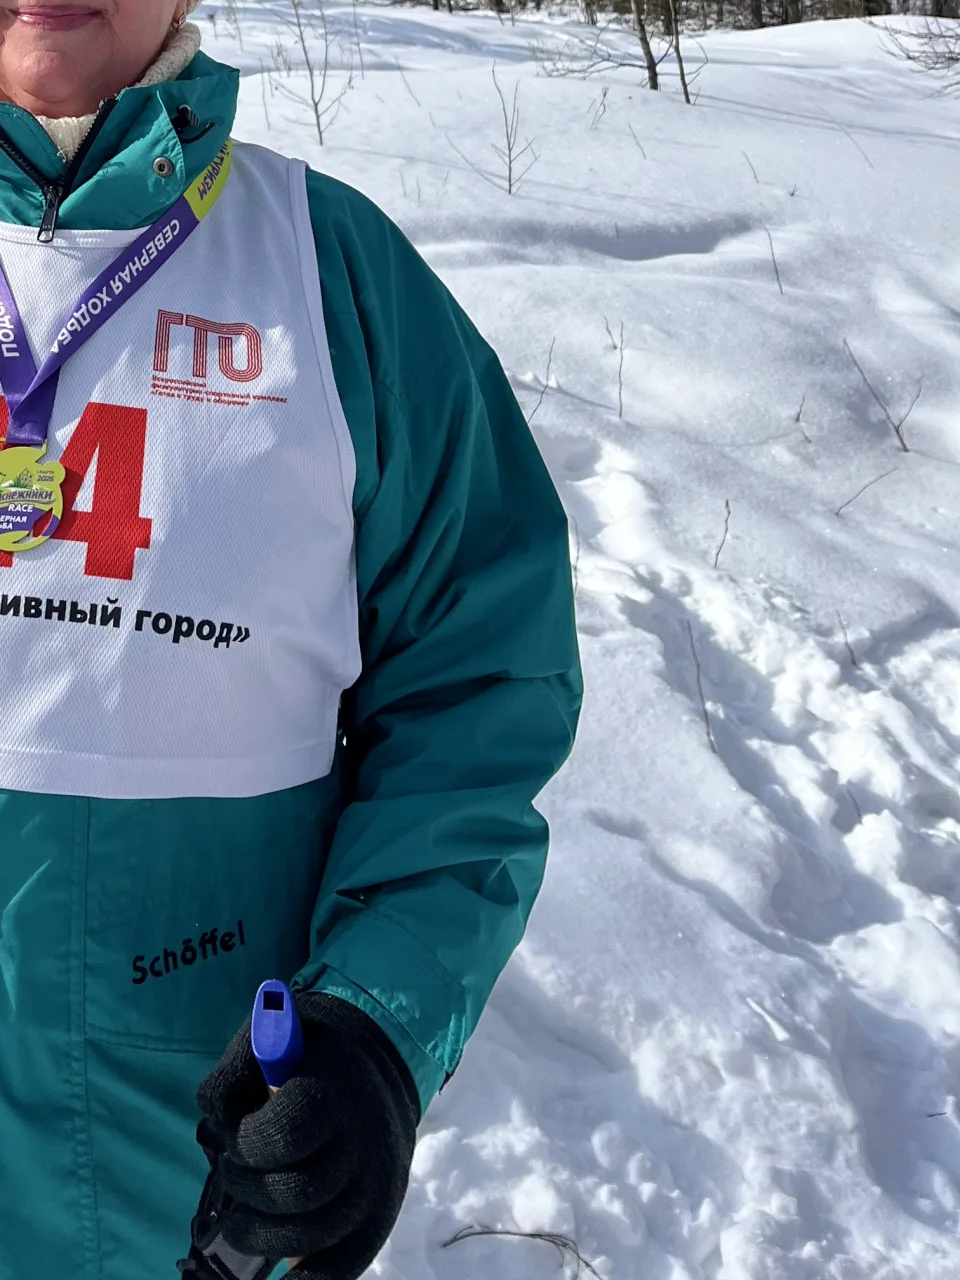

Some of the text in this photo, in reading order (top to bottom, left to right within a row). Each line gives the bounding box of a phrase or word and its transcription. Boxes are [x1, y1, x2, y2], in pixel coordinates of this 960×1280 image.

[110, 219, 181, 295] СЕВЕРНАЯ
[153, 309, 263, 382] ГТО
[8, 504, 34, 512] RACE
[134, 609, 252, 648] город»
